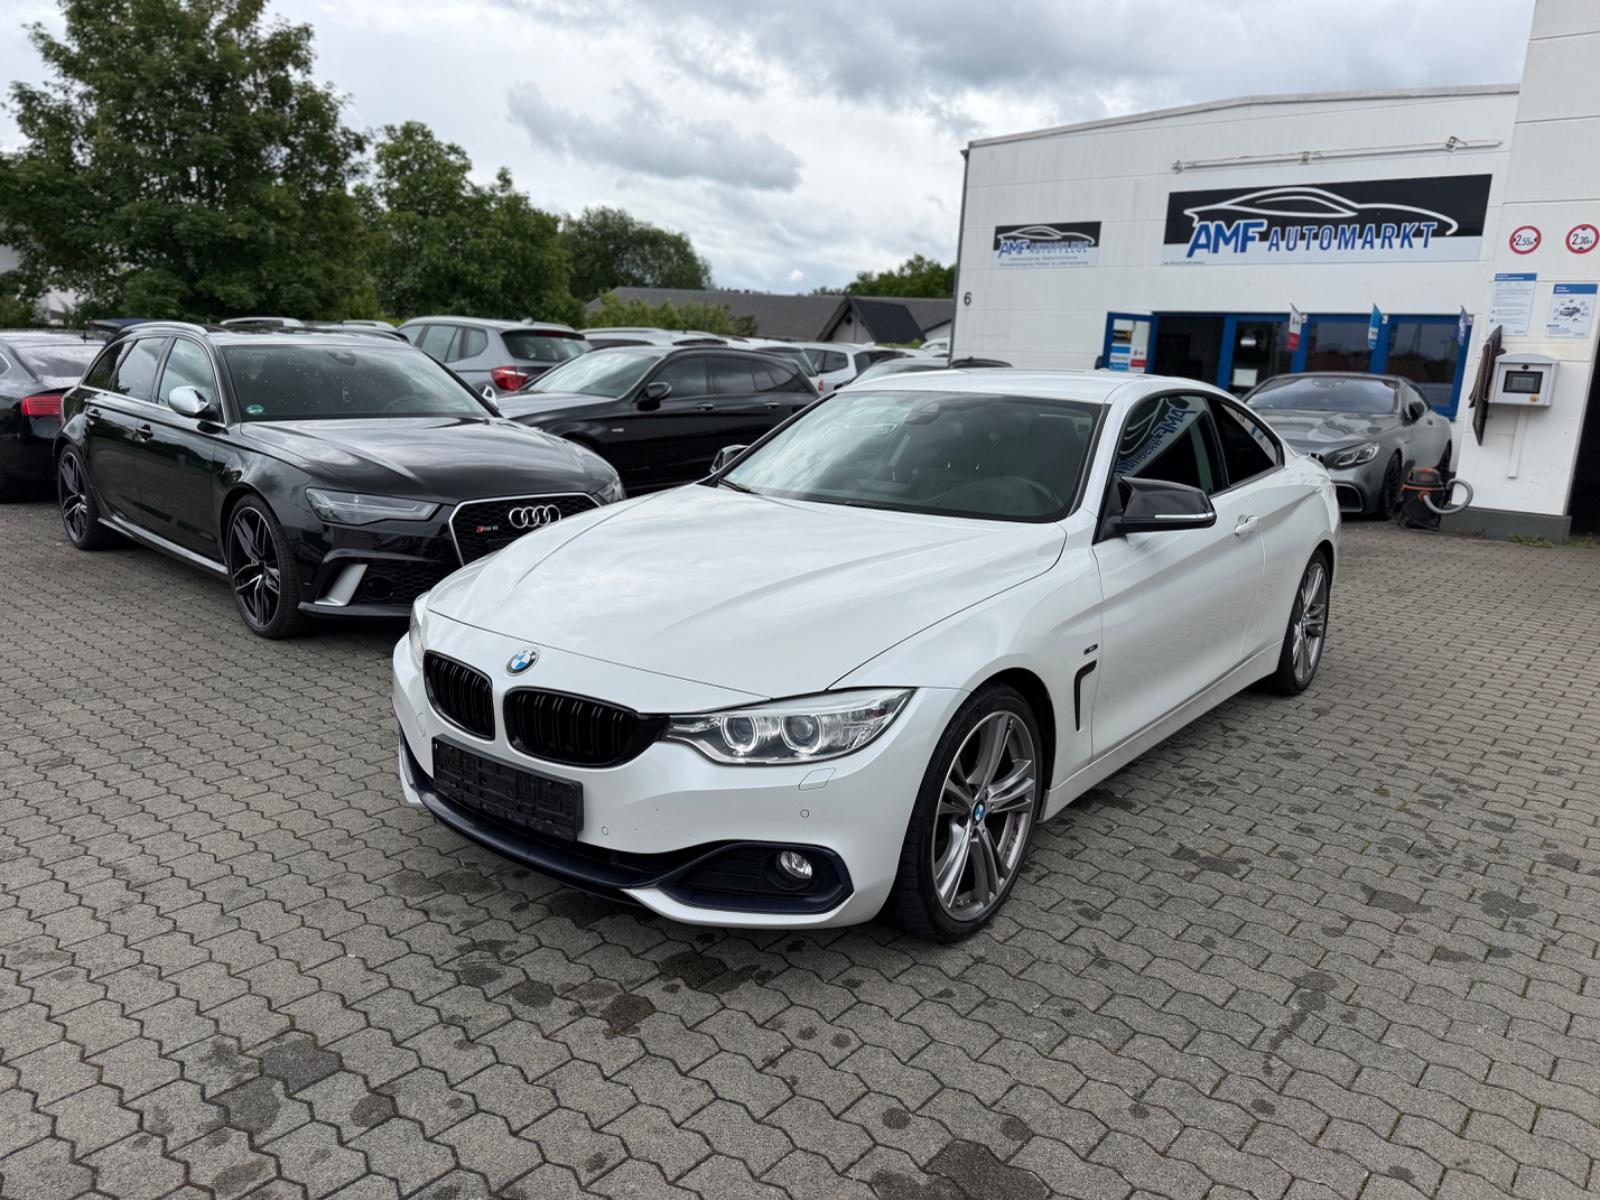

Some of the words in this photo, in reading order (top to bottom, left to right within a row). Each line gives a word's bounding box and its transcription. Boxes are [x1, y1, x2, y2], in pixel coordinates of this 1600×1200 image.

[1185, 219, 1267, 258] AMF
[1266, 222, 1437, 252] AUTOMARKT
[998, 239, 1030, 257] AMF
[963, 291, 972, 306] 6
